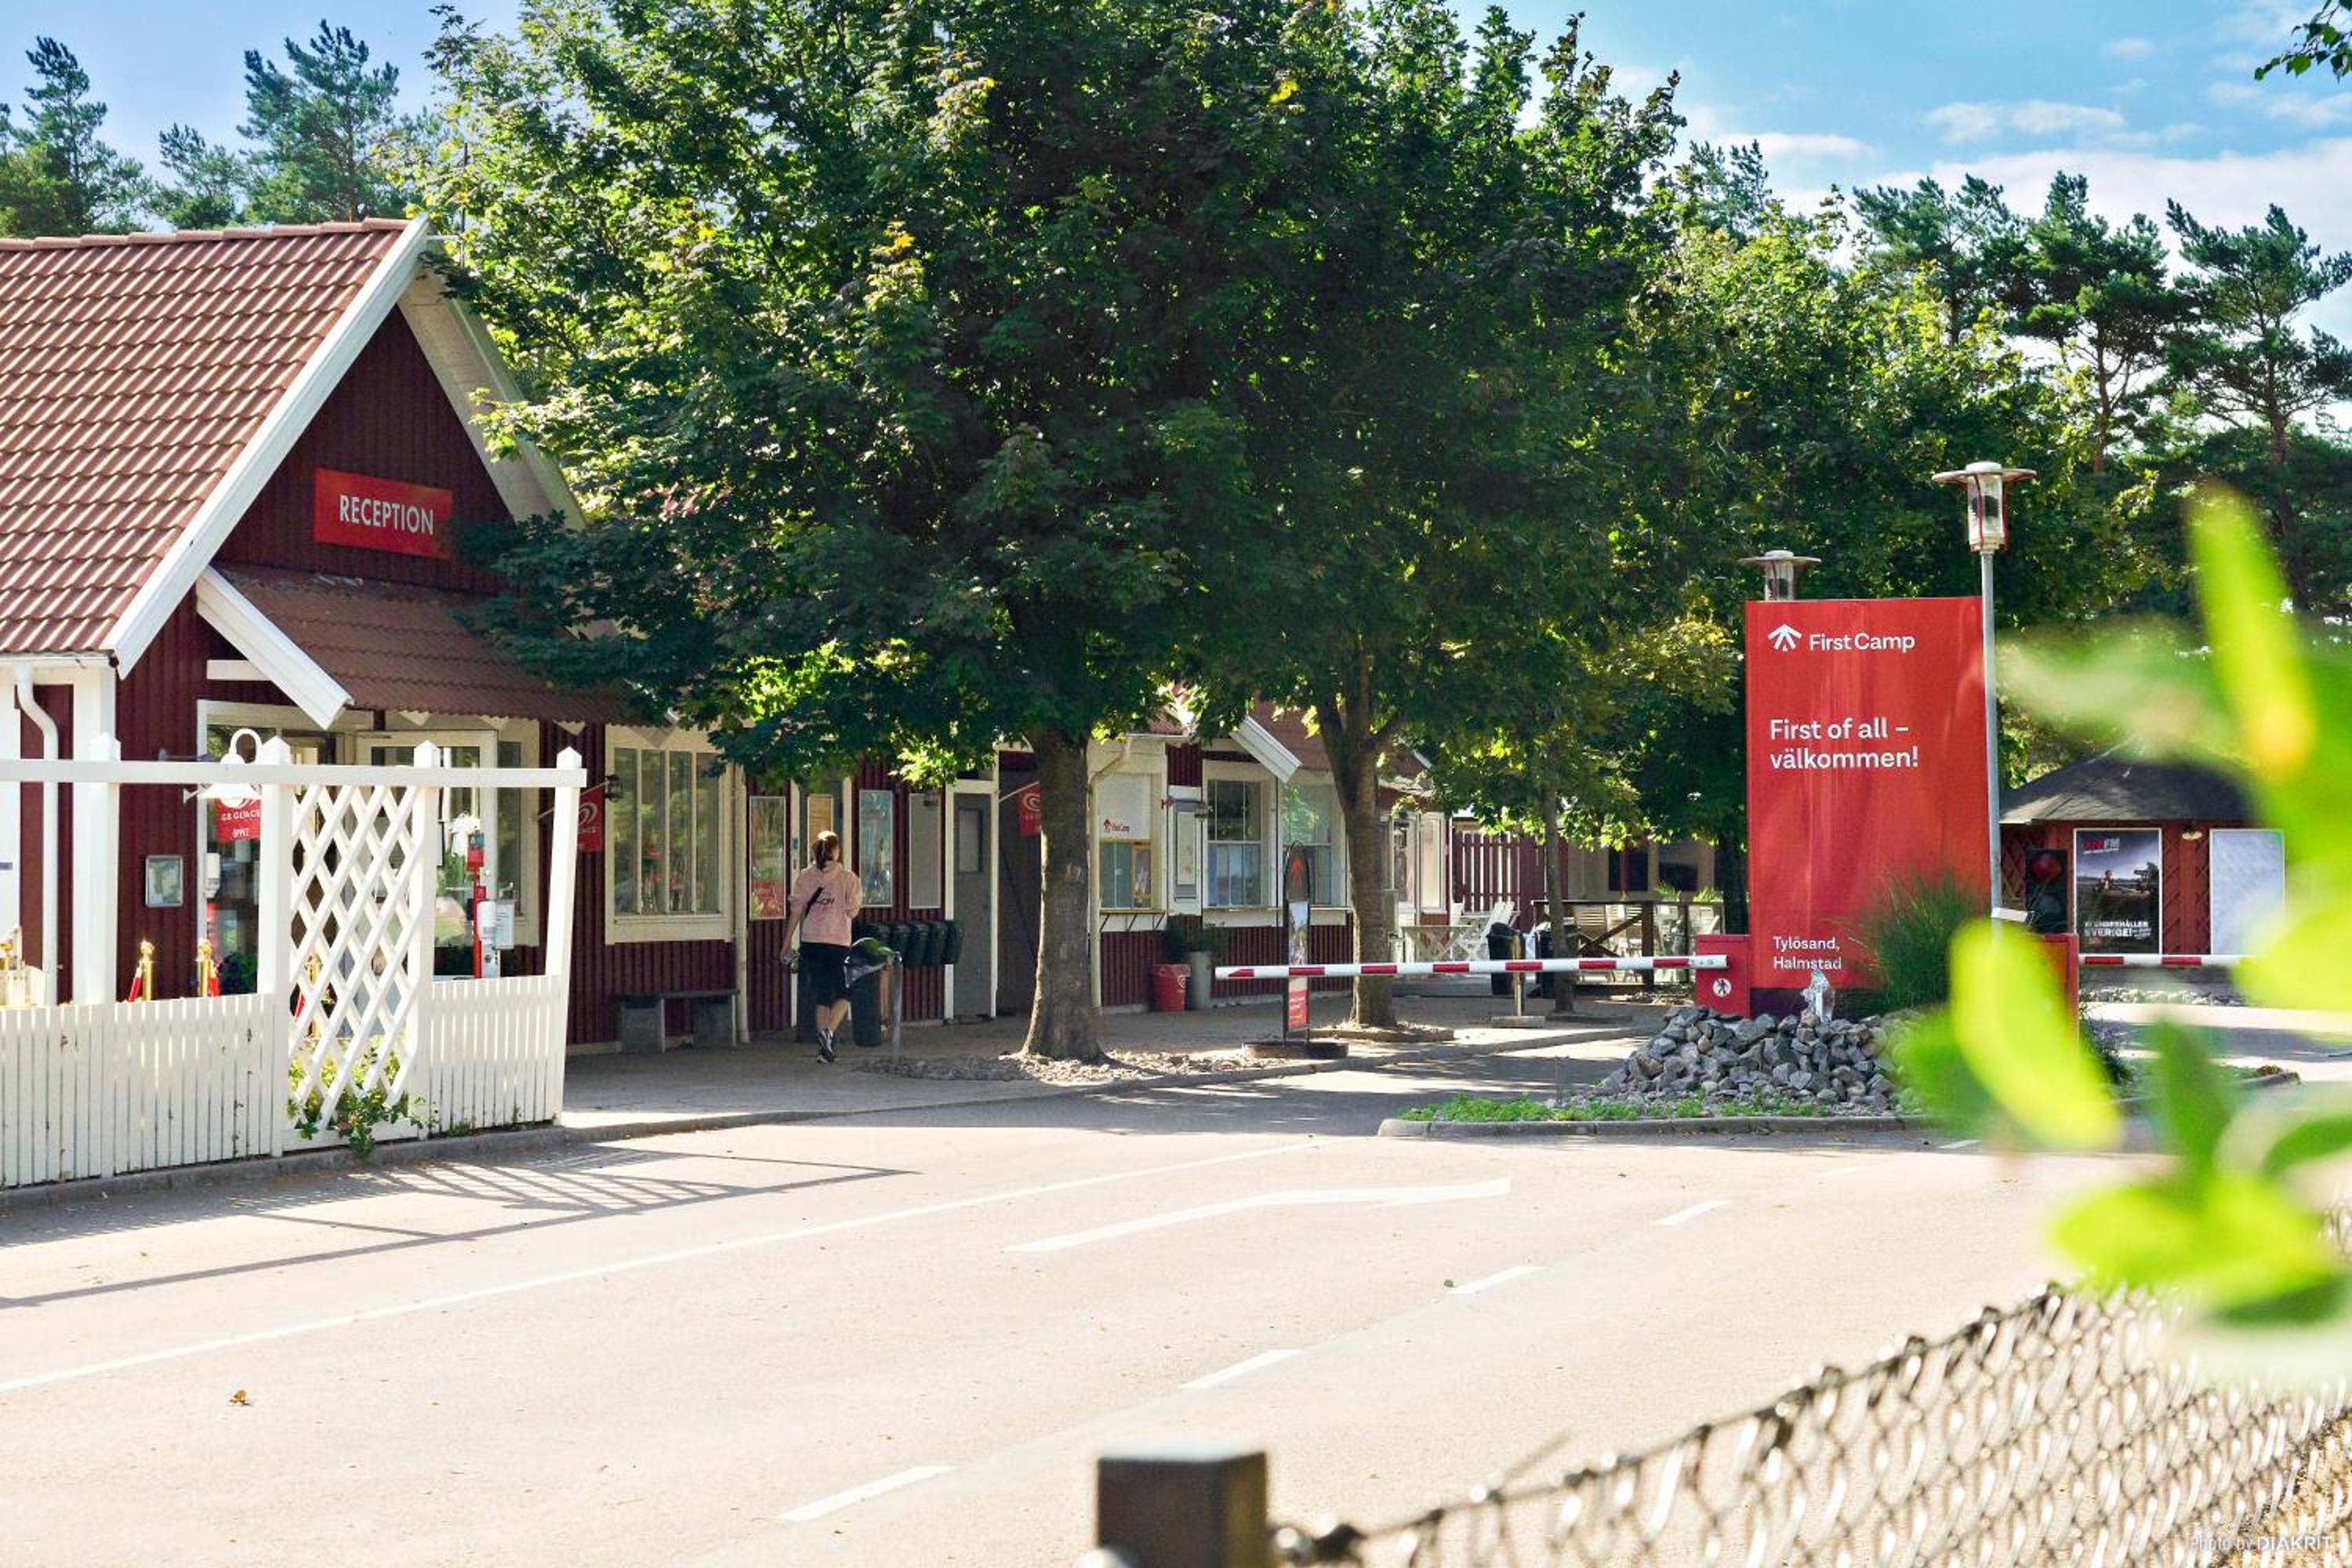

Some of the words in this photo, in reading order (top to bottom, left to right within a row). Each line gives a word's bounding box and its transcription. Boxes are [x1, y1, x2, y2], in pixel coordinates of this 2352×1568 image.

[339, 493, 434, 535] RECEPTION
[1809, 633, 1852, 652] First
[1854, 633, 1916, 653] Camp
[1769, 719, 1822, 740] First
[1828, 717, 1853, 740] of
[1858, 717, 1889, 739] all
[1769, 746, 1918, 770] välkommen!
[1773, 936, 1840, 952] Tylösand,
[1773, 956, 1842, 970] Halmstad
